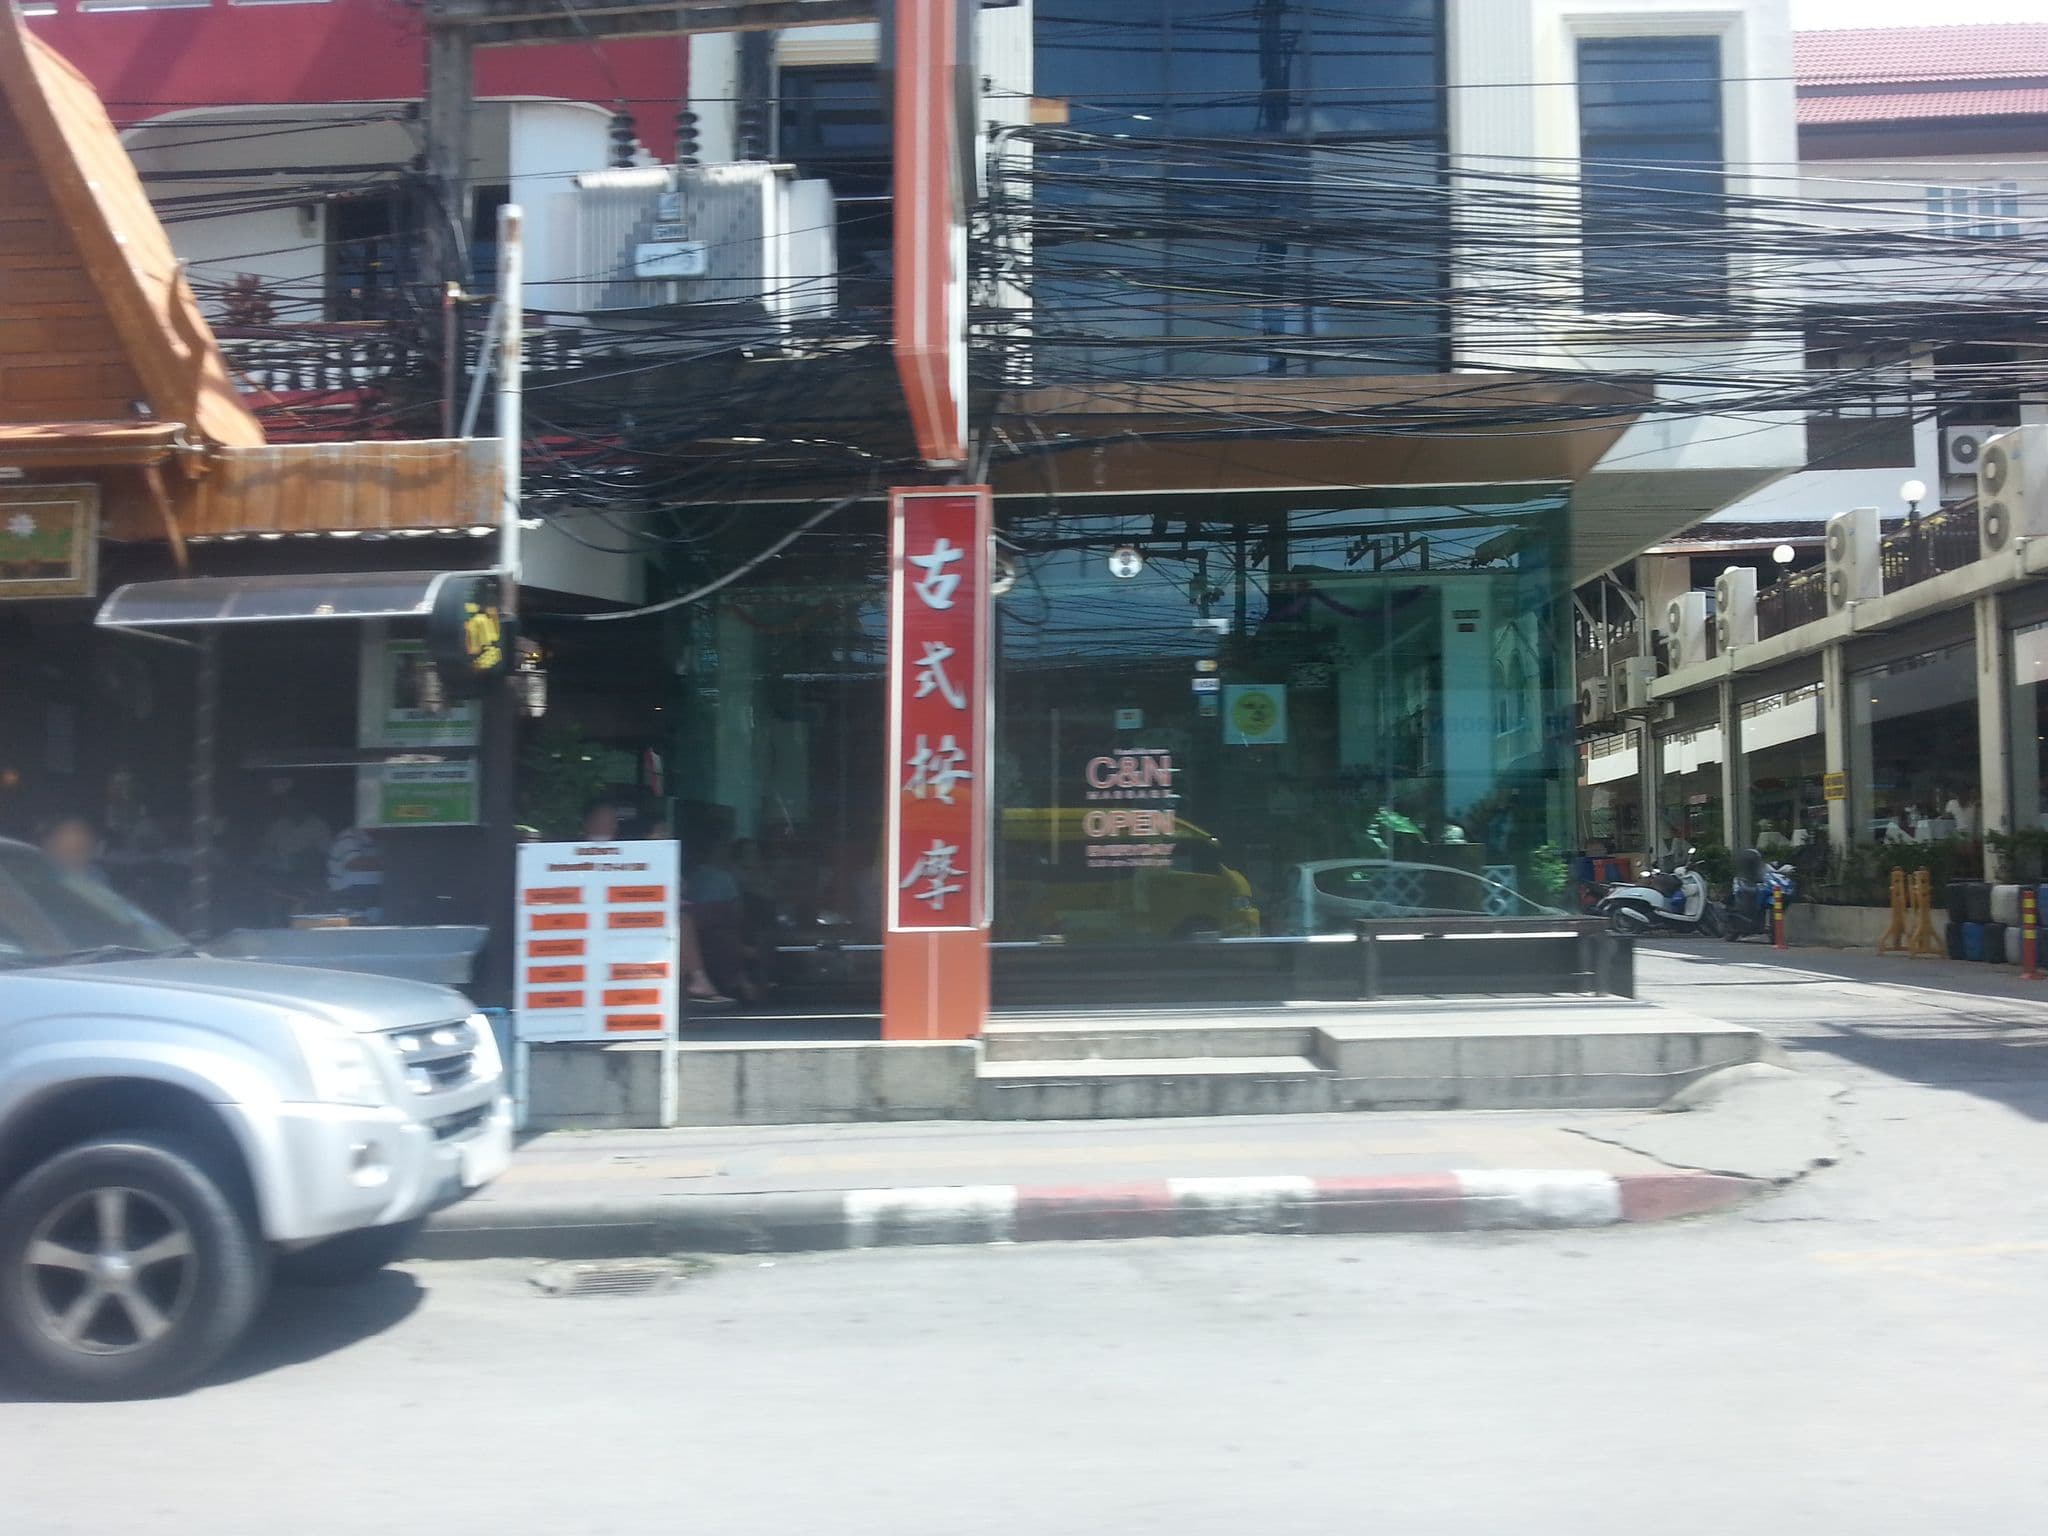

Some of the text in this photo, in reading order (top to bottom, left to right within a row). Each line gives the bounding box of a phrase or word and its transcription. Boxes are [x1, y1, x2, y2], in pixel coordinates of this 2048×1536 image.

[900, 538, 974, 910] 古式按摩
[1085, 756, 1172, 789] C&N
[1083, 809, 1176, 837] OPEN
